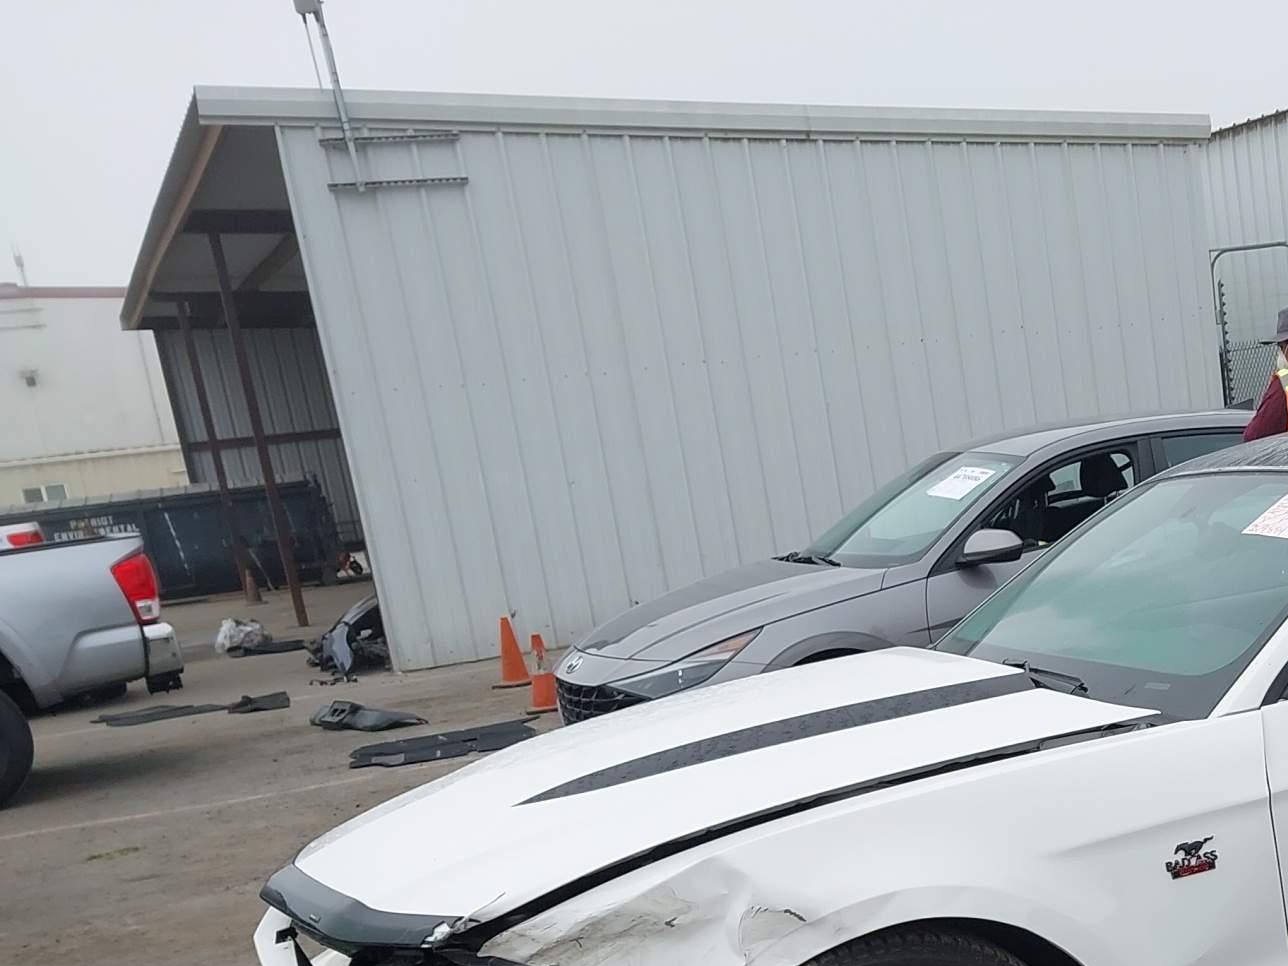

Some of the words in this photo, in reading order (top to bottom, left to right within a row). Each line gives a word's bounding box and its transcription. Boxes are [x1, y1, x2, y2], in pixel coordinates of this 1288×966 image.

[53, 523, 140, 542] ENVIRMENTAL
[1165, 857, 1191, 873] BAD
[1195, 849, 1219, 866] ASS
